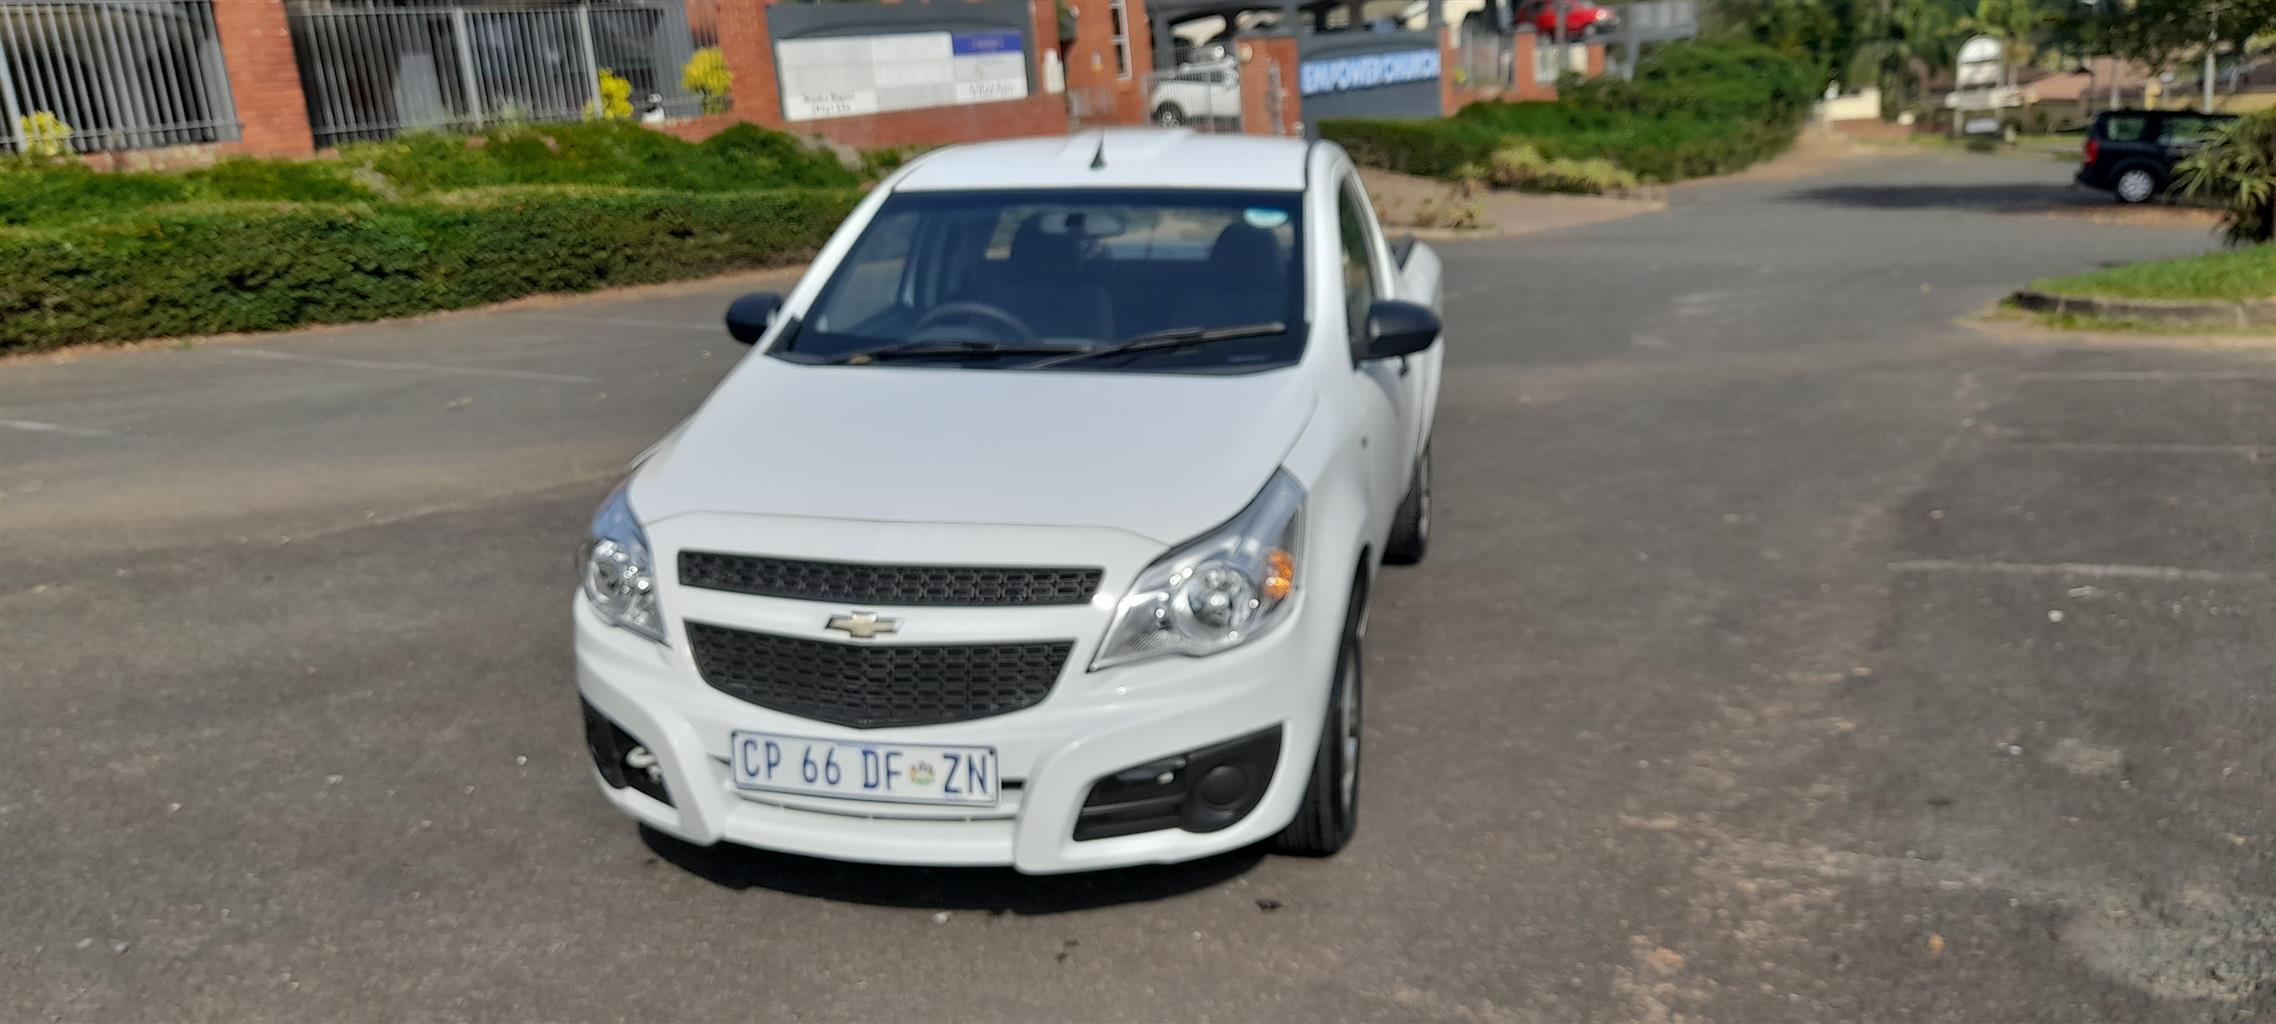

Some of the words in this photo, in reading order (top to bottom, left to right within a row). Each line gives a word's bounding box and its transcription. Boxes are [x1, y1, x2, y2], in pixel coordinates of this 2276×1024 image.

[743, 739, 781, 779] CP
[802, 745, 841, 786] 66
[862, 749, 904, 790] DF
[943, 752, 989, 795] ZN
